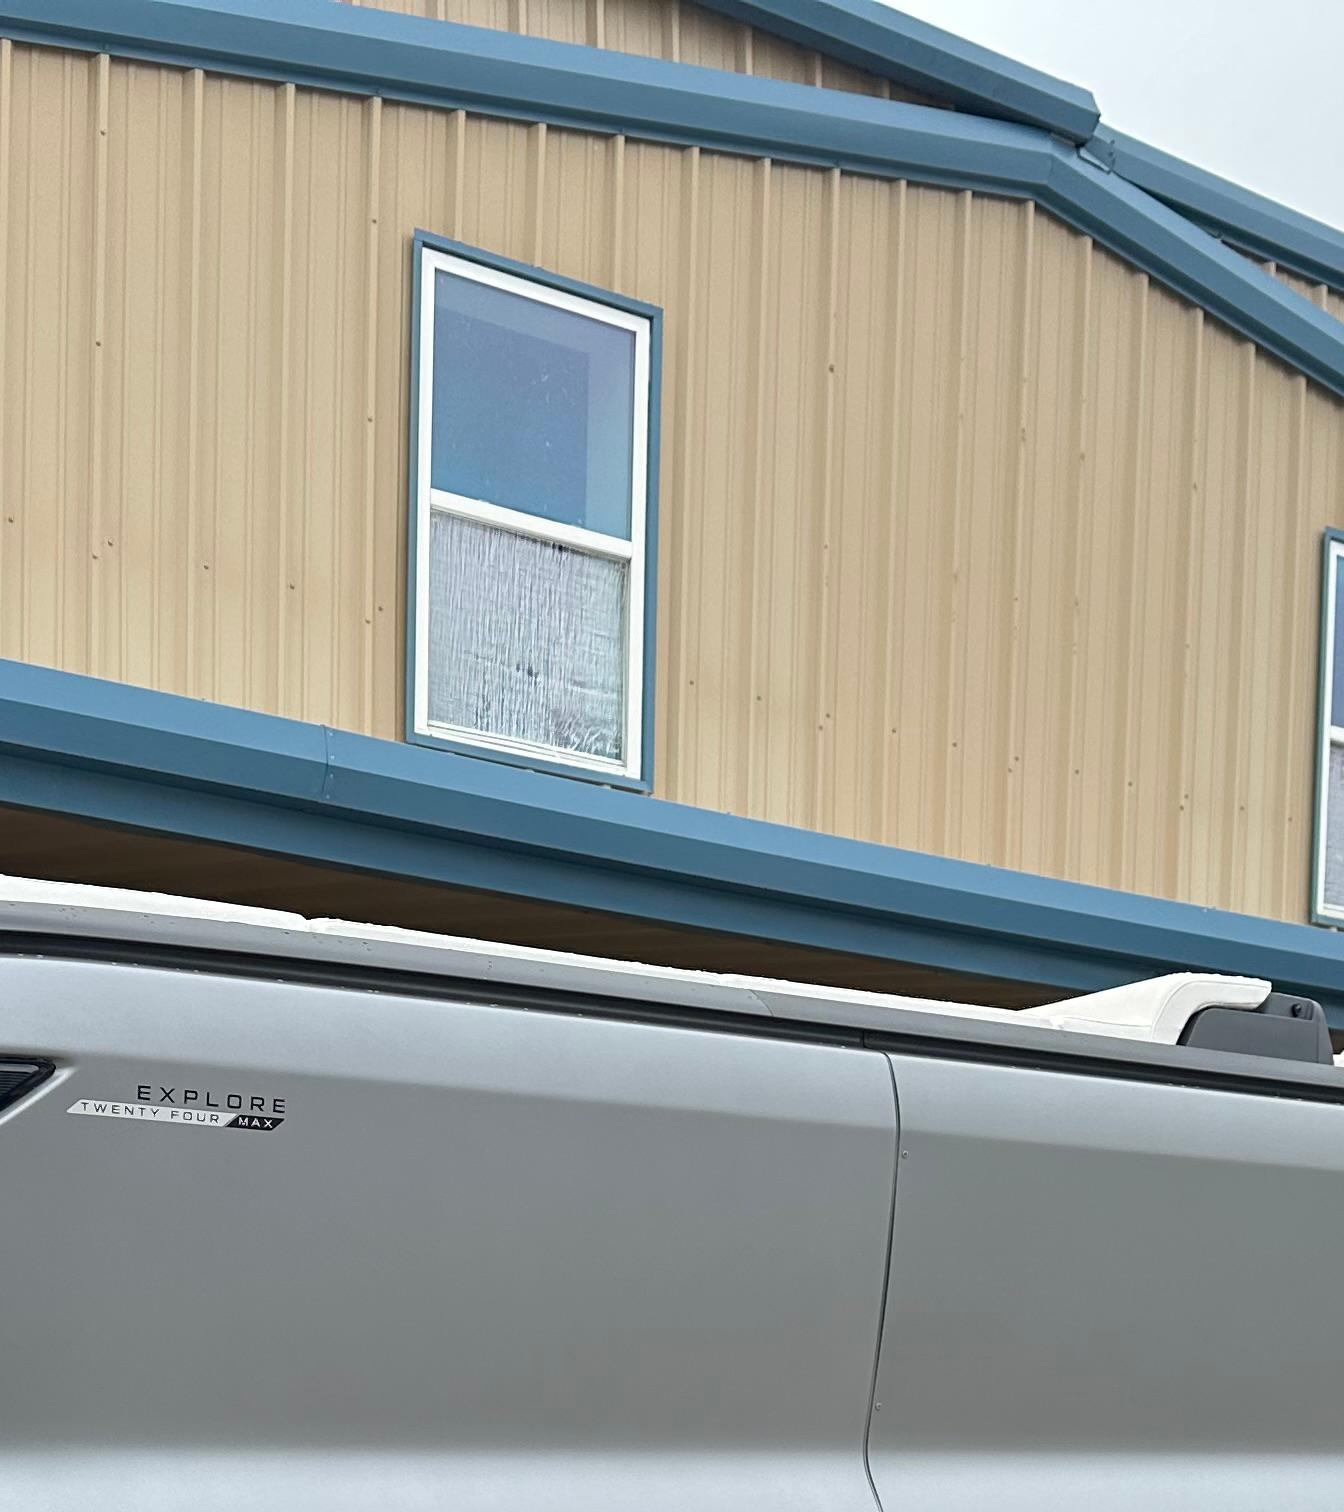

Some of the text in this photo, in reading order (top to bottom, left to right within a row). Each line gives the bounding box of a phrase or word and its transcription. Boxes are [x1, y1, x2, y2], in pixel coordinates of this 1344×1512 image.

[136, 1085, 286, 1113] EXPLORE
[80, 1101, 274, 1129] TWENTY FOUR MAX
